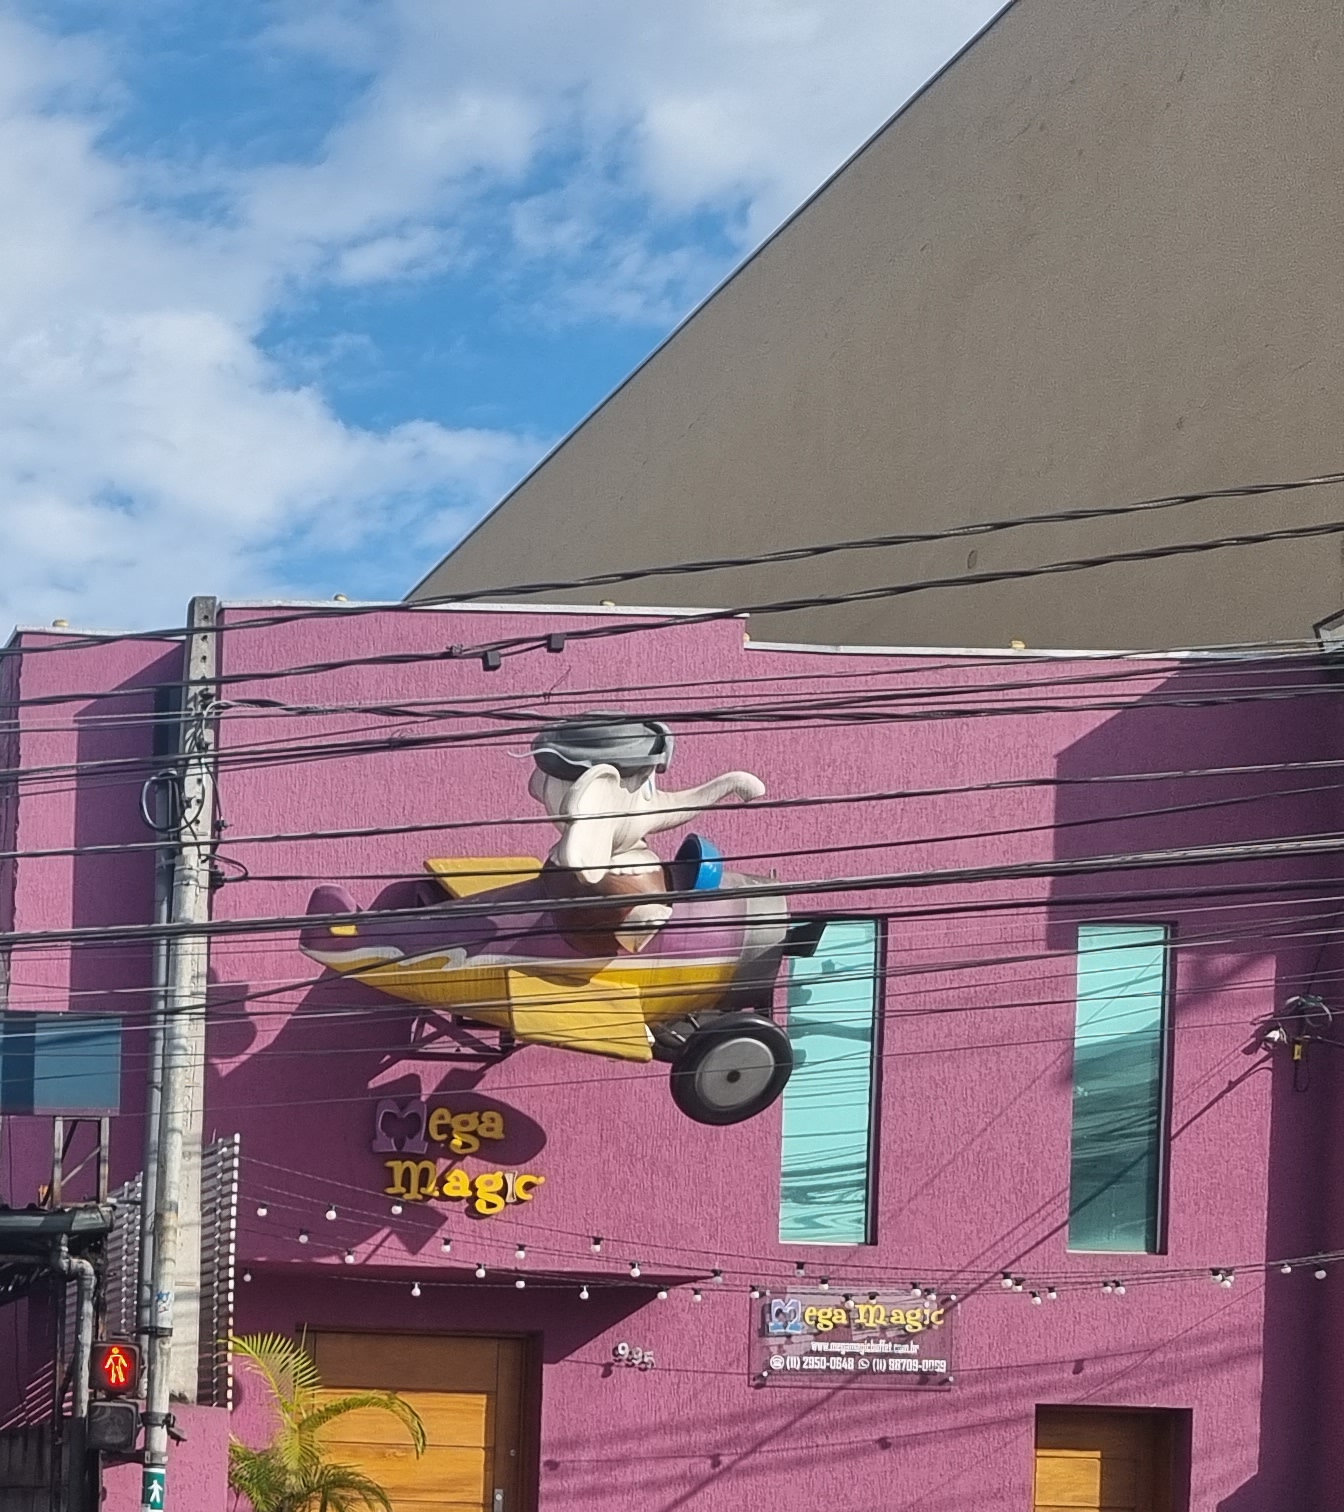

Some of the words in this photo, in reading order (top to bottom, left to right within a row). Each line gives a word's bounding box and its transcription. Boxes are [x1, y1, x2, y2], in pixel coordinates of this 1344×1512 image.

[372, 1100, 505, 1154] Mega
[384, 1160, 546, 1215] Magic
[768, 1298, 848, 1334] Mega
[854, 1303, 945, 1333] Magic
[617, 1342, 656, 1369] 995
